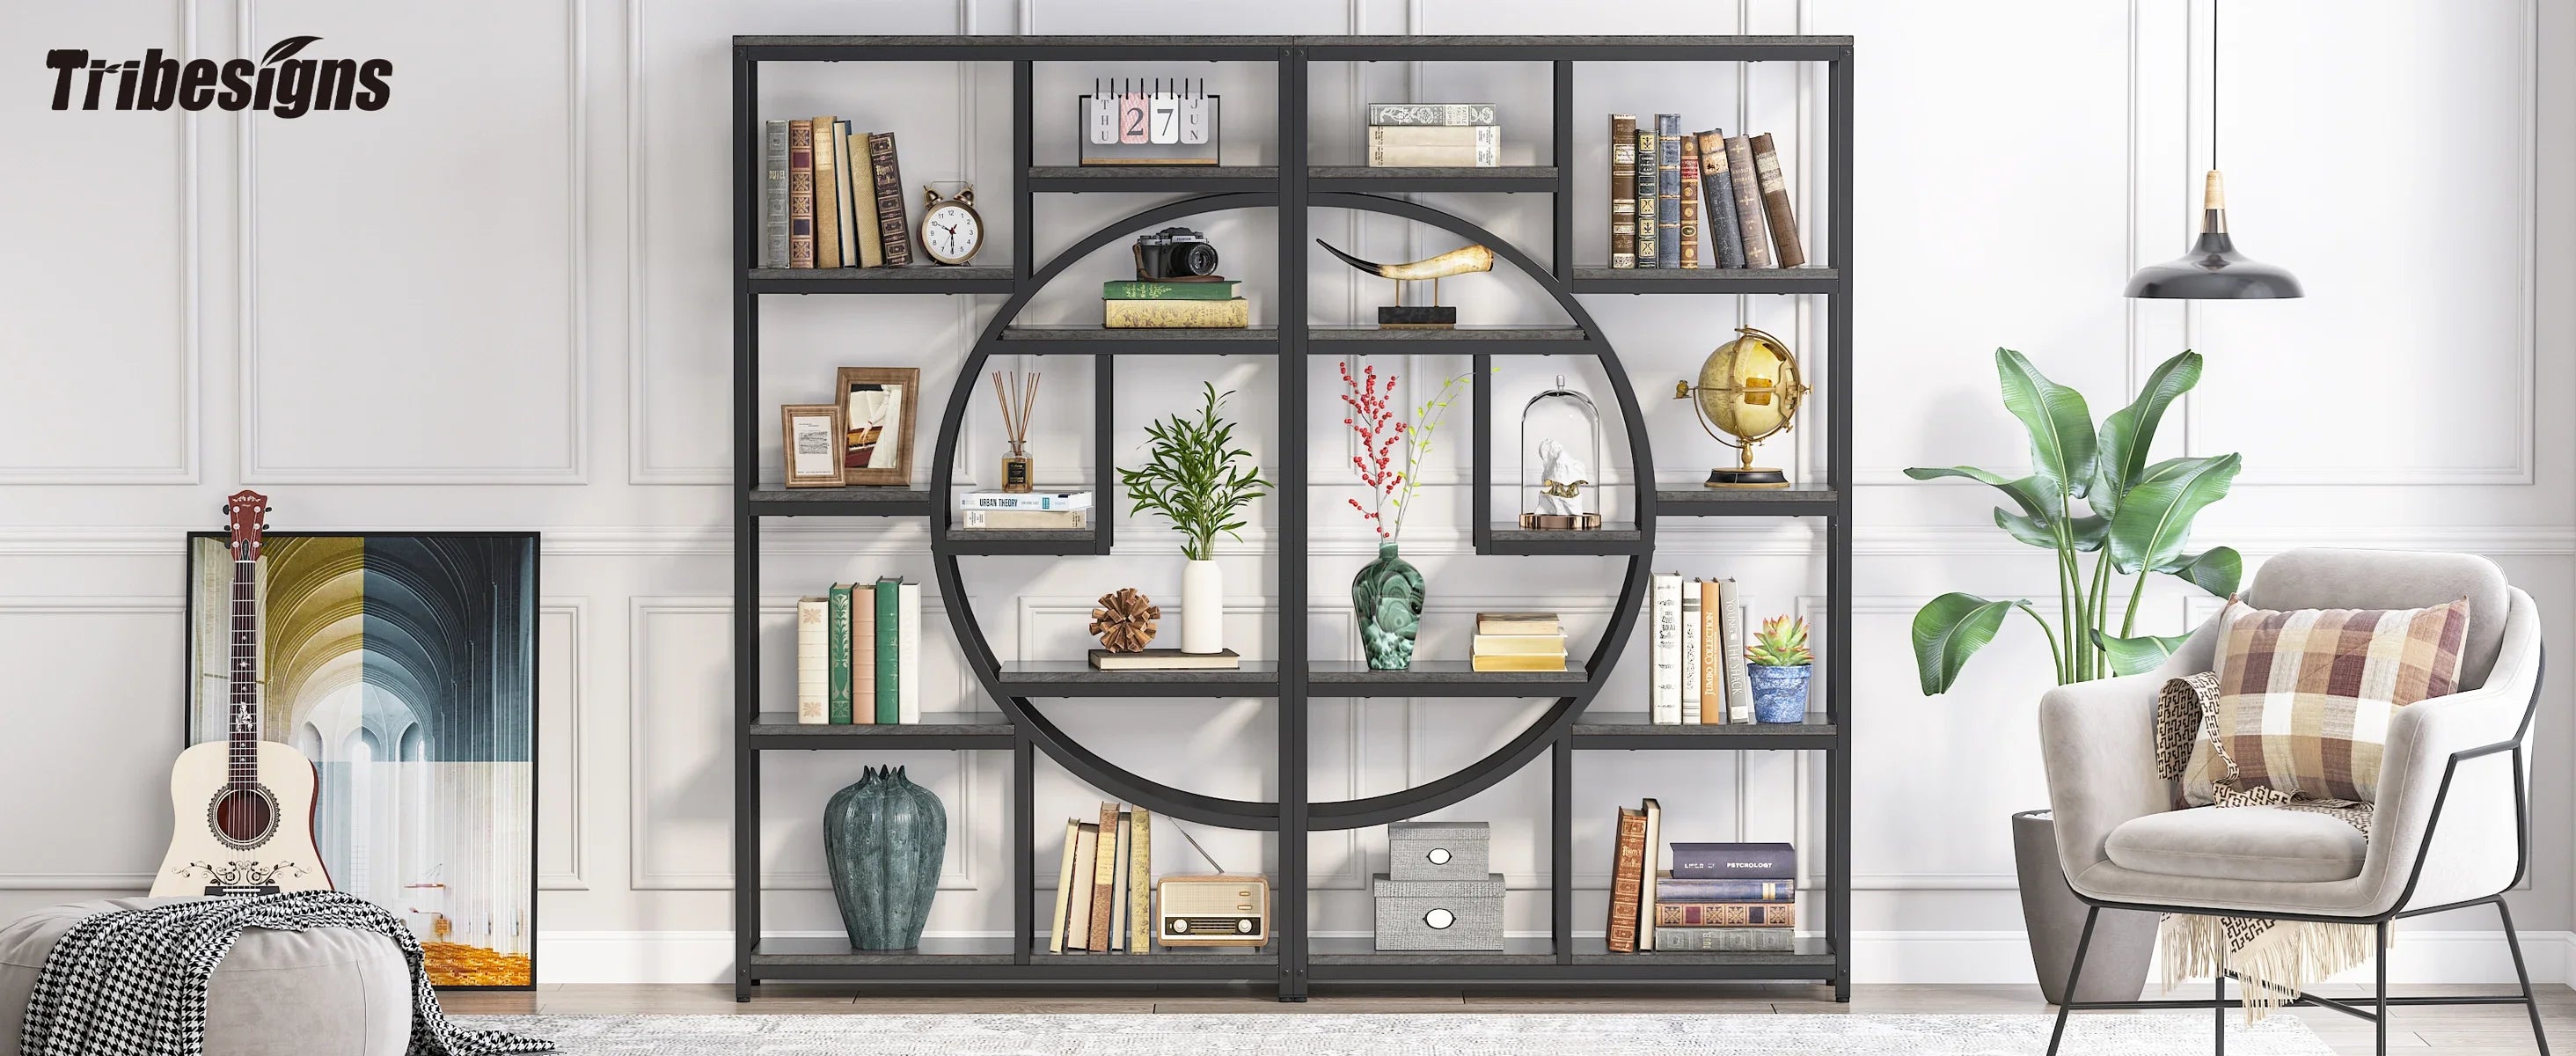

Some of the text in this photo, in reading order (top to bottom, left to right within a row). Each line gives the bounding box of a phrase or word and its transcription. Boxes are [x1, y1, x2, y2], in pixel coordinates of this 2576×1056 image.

[1101, 99, 1109, 142] THU
[1190, 99, 1199, 141] JUN
[979, 498, 997, 507] URBAN
[999, 498, 1018, 507] THEORY
[1704, 612, 1714, 664] COLLECTION
[1725, 598, 1743, 695] YOUNG THE SHACK
[1704, 666, 1716, 695] JUMBO
